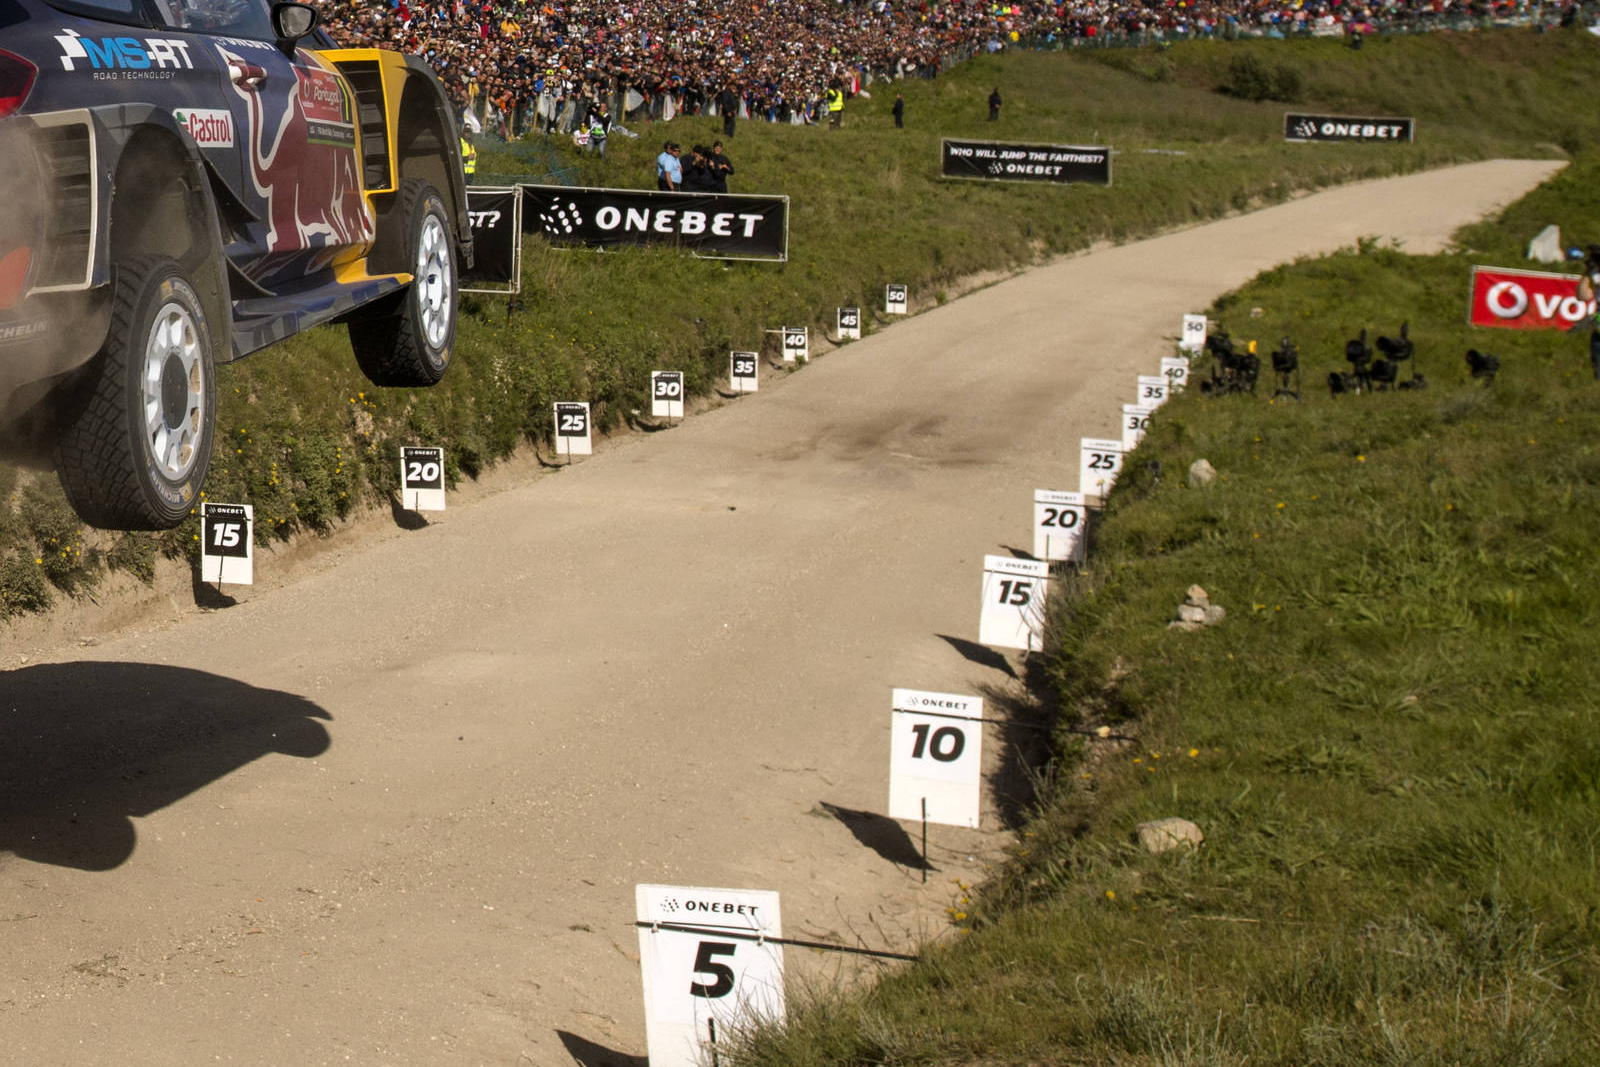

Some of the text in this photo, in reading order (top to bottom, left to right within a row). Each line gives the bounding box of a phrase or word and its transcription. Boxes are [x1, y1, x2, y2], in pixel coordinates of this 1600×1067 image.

[78, 37, 194, 70] MS-RT
[93, 71, 176, 80] ROAD TECHNOLOGY
[189, 113, 232, 143] Castrol
[1321, 123, 1403, 138] ONEBET
[950, 147, 1105, 164] WHO WILL JUMP THE FARTHEST?
[1006, 163, 1063, 175] ONEBET
[594, 205, 764, 238] ONEBET
[889, 291, 905, 301] 50
[841, 315, 857, 326] 45
[1187, 322, 1203, 331] 50
[786, 334, 805, 346] 40
[735, 361, 754, 374] 35
[1165, 368, 1184, 378] 40
[656, 382, 680, 396] 30
[1143, 387, 1163, 399] 35
[560, 415, 585, 431] 25
[1088, 453, 1116, 470] 25
[407, 462, 440, 482] 20
[217, 507, 244, 515] ONEBET
[1041, 508, 1079, 529] 20
[213, 523, 241, 547] 15
[998, 580, 1033, 606] 15
[921, 698, 969, 710] ONEBET
[911, 724, 966, 762] 10
[685, 899, 759, 916] ONEBET
[689, 940, 737, 999] 5
